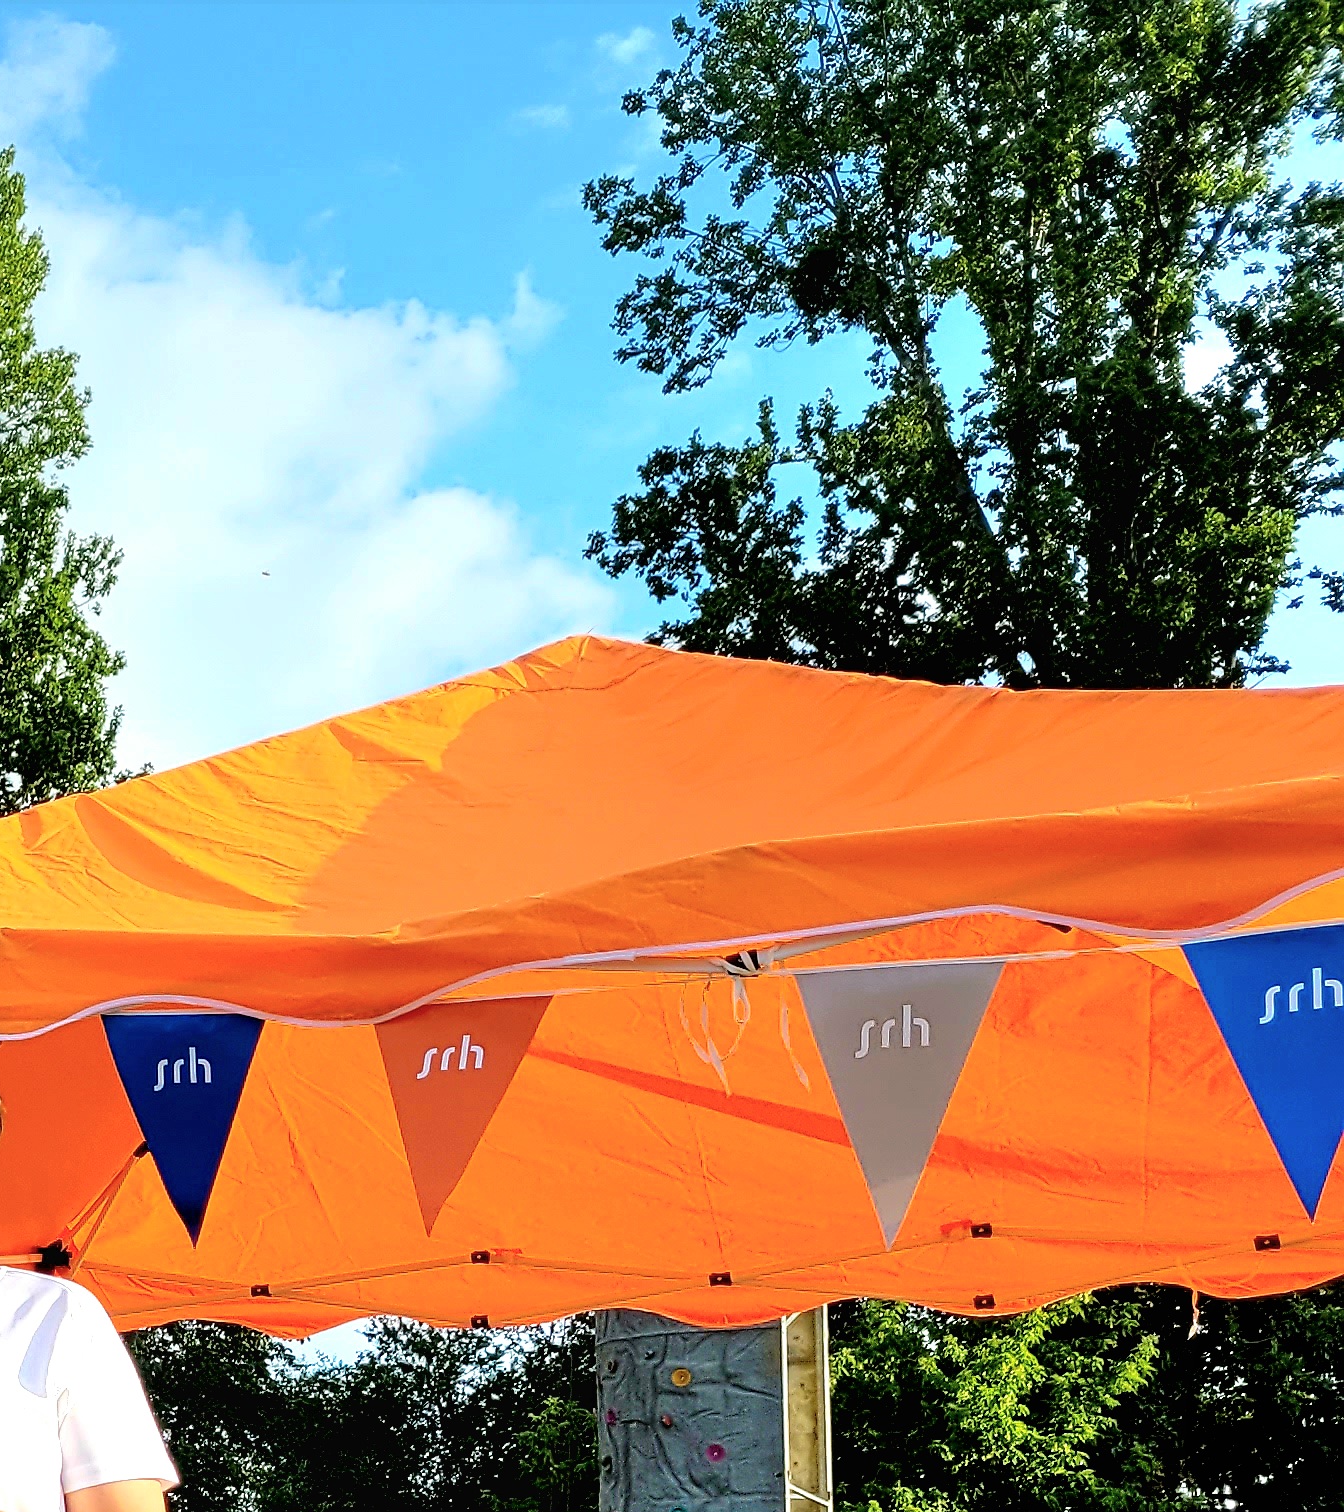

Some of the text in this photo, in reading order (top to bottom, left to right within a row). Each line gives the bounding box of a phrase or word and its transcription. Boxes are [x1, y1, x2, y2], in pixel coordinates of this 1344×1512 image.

[1259, 967, 1344, 1025] srh
[854, 1004, 930, 1059] srh
[153, 1046, 212, 1092] srh
[416, 1034, 484, 1080] srh
